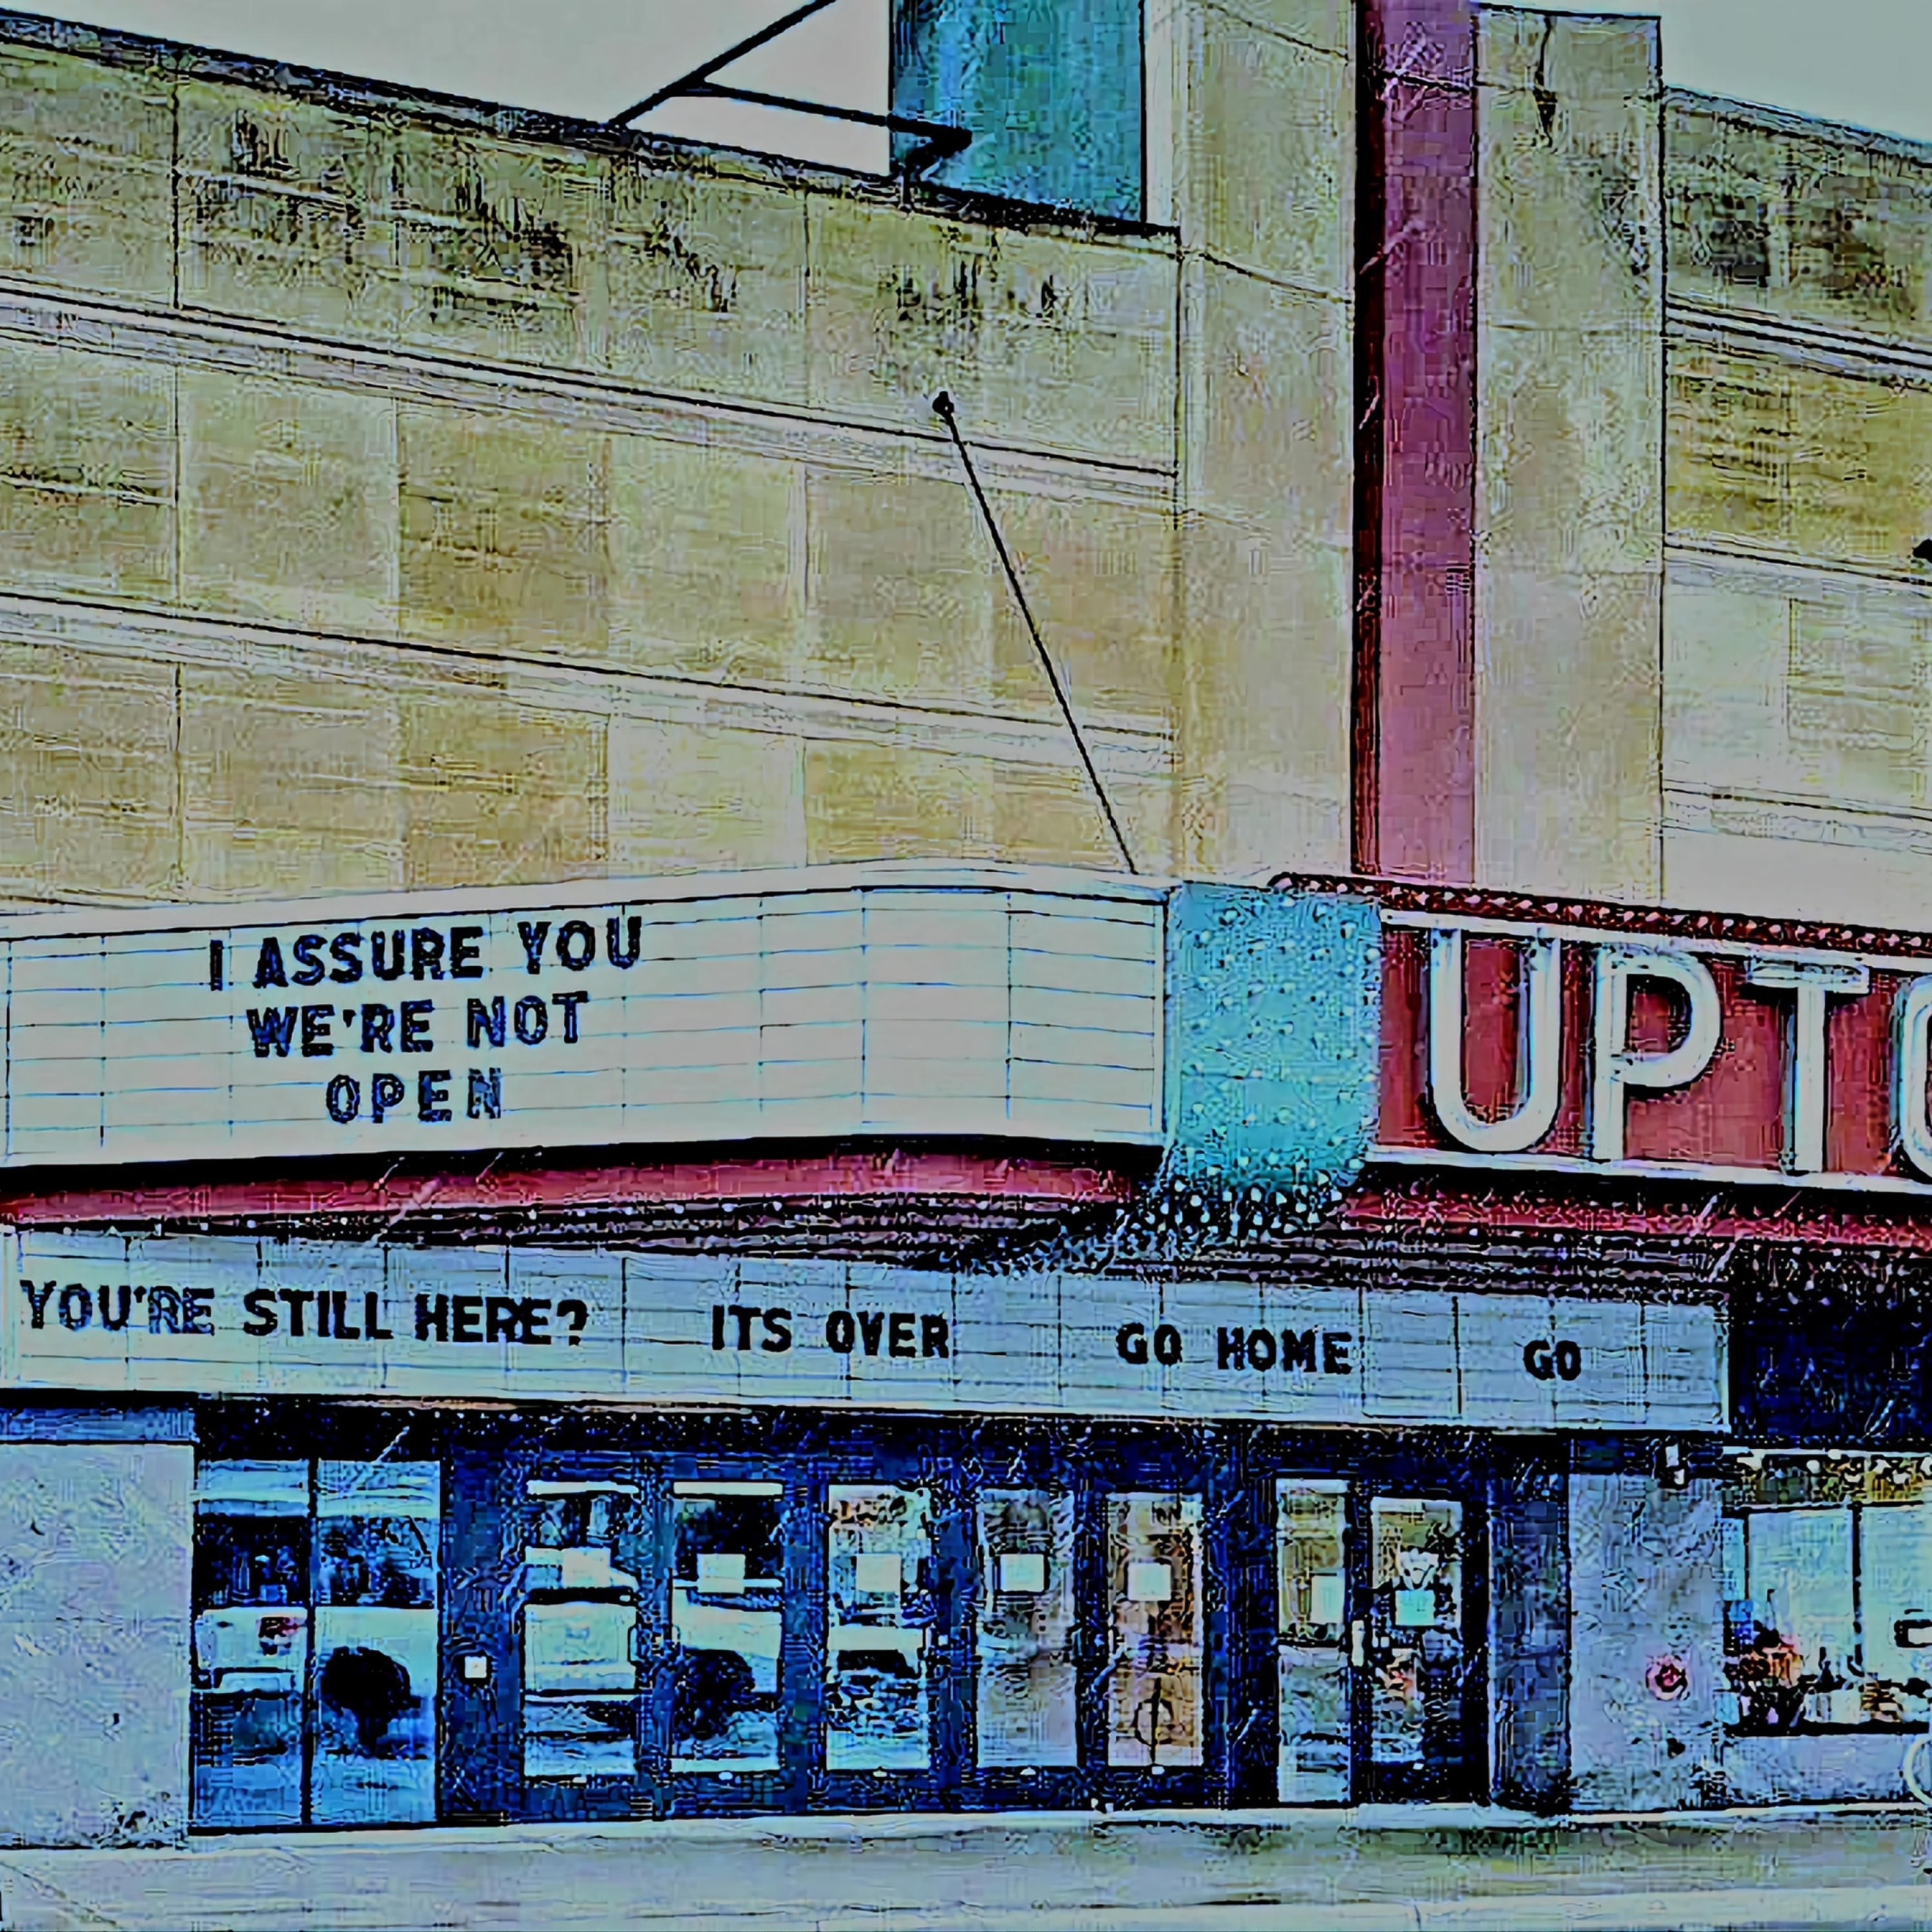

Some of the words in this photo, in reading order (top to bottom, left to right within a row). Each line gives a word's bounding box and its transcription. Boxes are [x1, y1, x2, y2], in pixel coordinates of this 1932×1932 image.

[210, 940, 223, 991] I
[253, 927, 483, 987] ASSURE
[518, 916, 642, 974] YOU
[247, 999, 434, 1057] WE'RE
[468, 992, 588, 1048] NOT
[326, 1068, 500, 1124] OPEN
[21, 1280, 214, 1335] YOU'RE
[244, 1289, 393, 1340] STILL
[415, 1293, 588, 1346] HERE?
[712, 1304, 792, 1352] ITS
[826, 1311, 950, 1358] OVER
[1117, 1322, 1183, 1365] GO
[1217, 1327, 1353, 1375] HOME
[1523, 1340, 1582, 1381] GO
